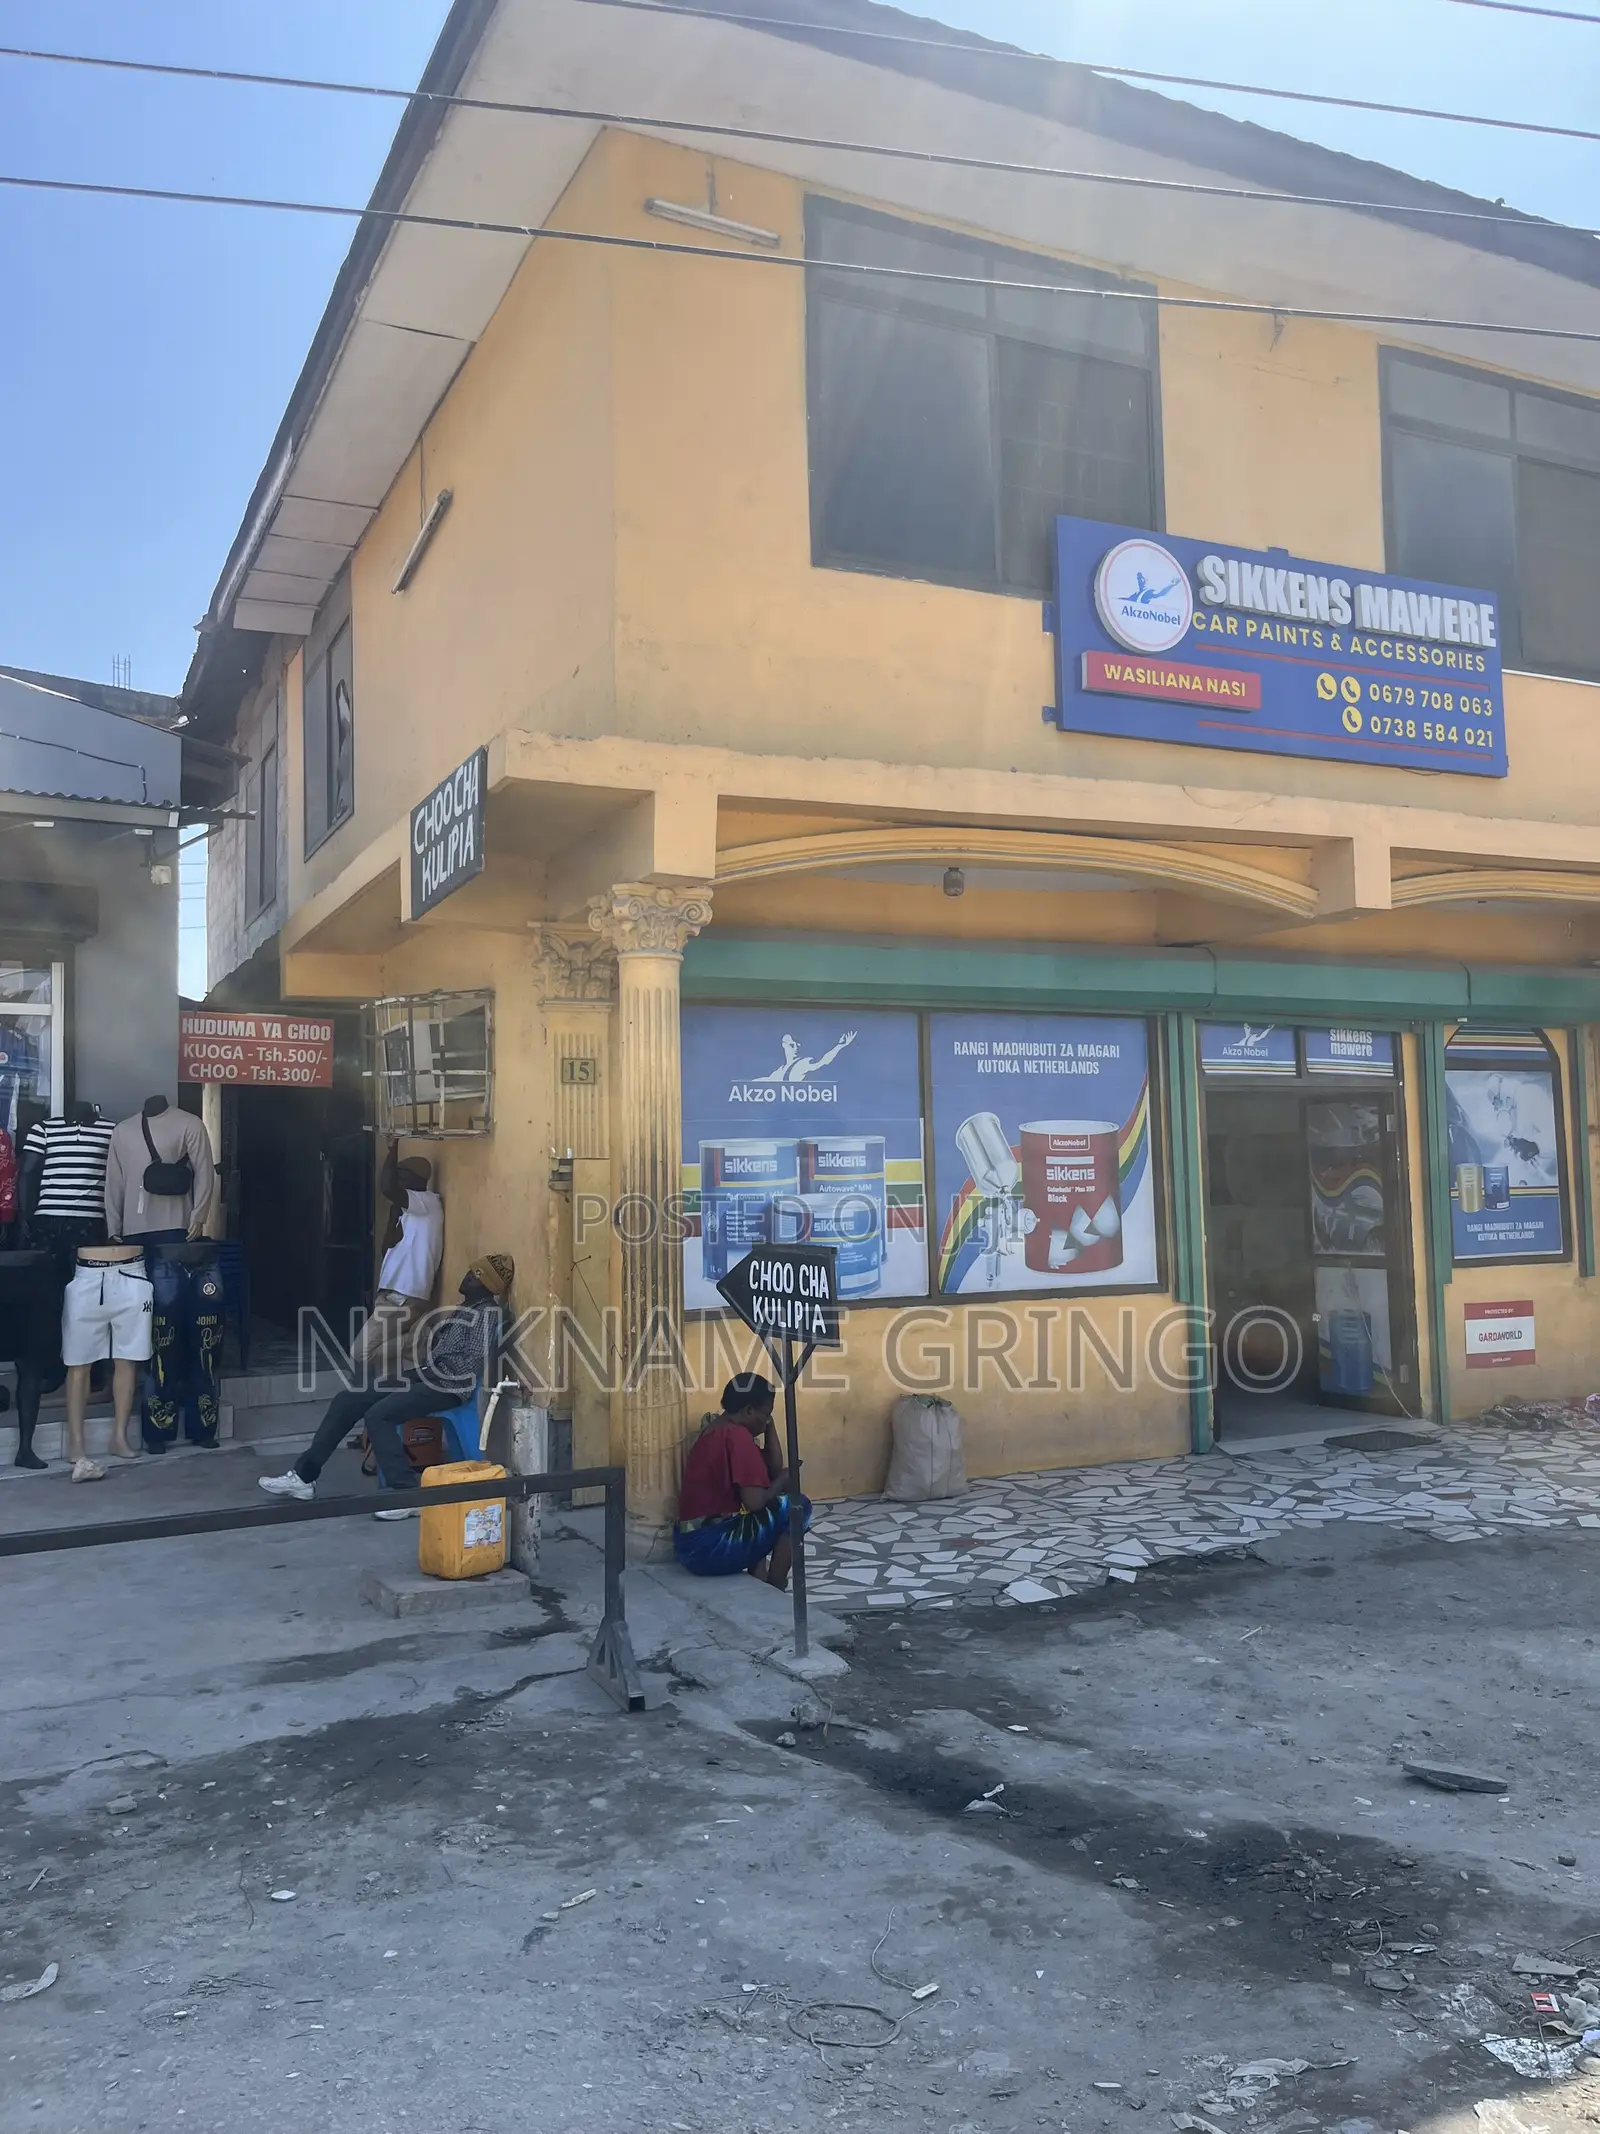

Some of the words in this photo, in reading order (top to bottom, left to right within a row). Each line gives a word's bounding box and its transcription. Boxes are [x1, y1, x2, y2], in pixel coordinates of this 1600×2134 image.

[1198, 555, 1352, 626] SIKKENS
[1354, 584, 1496, 648] MAWERE
[1121, 605, 1181, 626] AkzoNobel
[1192, 612, 1238, 635] CAR
[1246, 619, 1324, 649] PAINTS
[1330, 633, 1342, 651] &
[1350, 636, 1486, 673] ACCESSORIES
[1104, 663, 1203, 691] WASILIANA
[1206, 677, 1246, 697] NASI
[1369, 683, 1415, 706] 0679
[1420, 690, 1454, 712] 708
[1459, 696, 1493, 717] 063
[1370, 715, 1417, 739] 0738
[1423, 722, 1459, 743] 584
[1464, 728, 1494, 748] 021
[414, 781, 453, 855] CHOO
[454, 755, 479, 817] CHA
[422, 813, 475, 902] KULIPIA
[182, 1018, 257, 1038] HUDUMA
[261, 1022, 283, 1039] YA
[287, 1024, 332, 1041] CHOO
[183, 1043, 244, 1060] KUOGA
[256, 1047, 328, 1065] Tsh.500/-
[954, 1041, 989, 1056] RANGI
[992, 1042, 1057, 1057] MADHUBUTI
[1060, 1043, 1075, 1057] ZA
[1077, 1044, 1121, 1059] MAGARI
[1221, 1046, 1243, 1057] Akzo
[1243, 1046, 1269, 1058] Nobel
[1330, 1042, 1373, 1057] mawere
[189, 1063, 238, 1079] CHOO
[251, 1065, 322, 1083] Tsh.300/-
[567, 1060, 590, 1081] 15
[977, 1059, 1021, 1074] KUTOKA
[1024, 1060, 1100, 1075] NETHERLANDS
[728, 1085, 776, 1103] Akzo
[781, 1085, 838, 1103] Nobel
[724, 1157, 778, 1174] sikkens
[818, 1153, 867, 1168] sikkens
[1046, 1166, 1096, 1181] sikkens
[858, 1184, 872, 1192] MM
[1047, 1193, 1068, 1203] Black
[813, 1219, 855, 1232] sikkens
[749, 1259, 795, 1294] CHOO
[799, 1263, 830, 1300] CHA
[196, 1314, 218, 1326] JOHN
[752, 1295, 827, 1335] KULIPIA
[1478, 1330, 1523, 1342] GARDAWORLD
